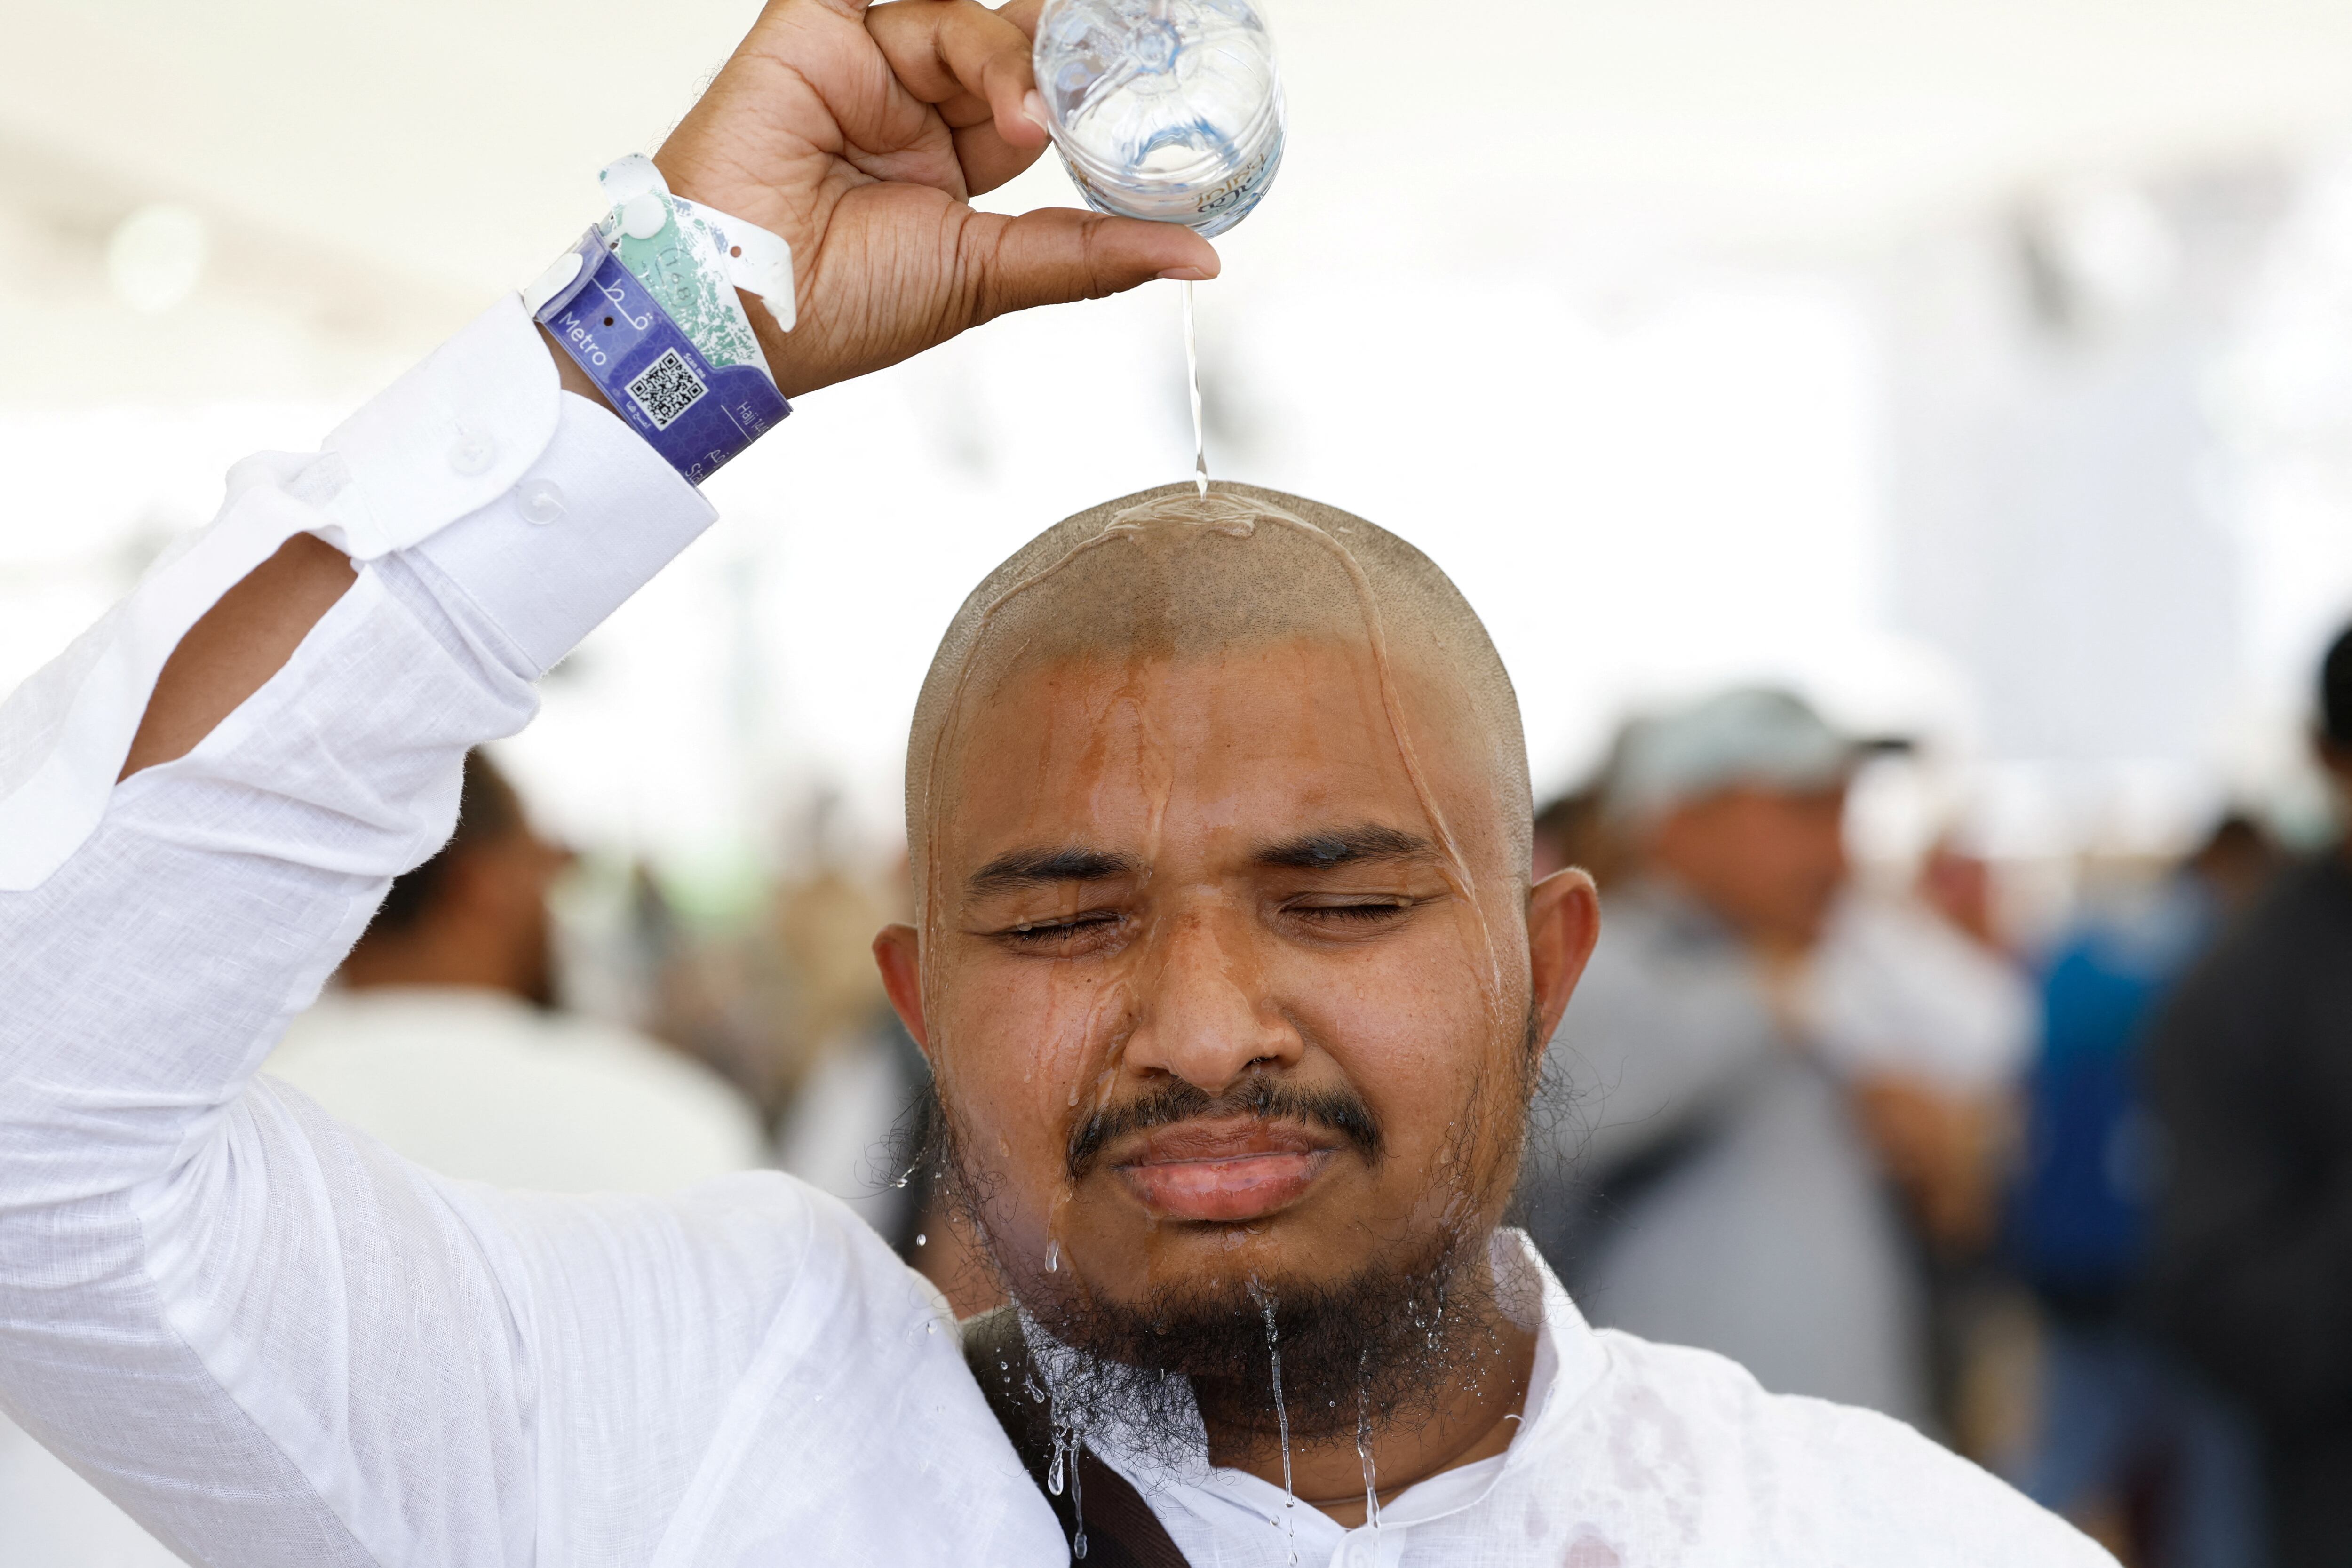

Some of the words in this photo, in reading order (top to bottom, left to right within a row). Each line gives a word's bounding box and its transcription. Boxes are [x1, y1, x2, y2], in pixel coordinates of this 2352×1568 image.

[665, 256, 691, 301] 168
[592, 277, 653, 330] قط
[558, 310, 607, 366] Metro
[683, 352, 698, 370] Scan
[695, 367, 706, 379] me
[736, 401, 759, 425] Hajj
